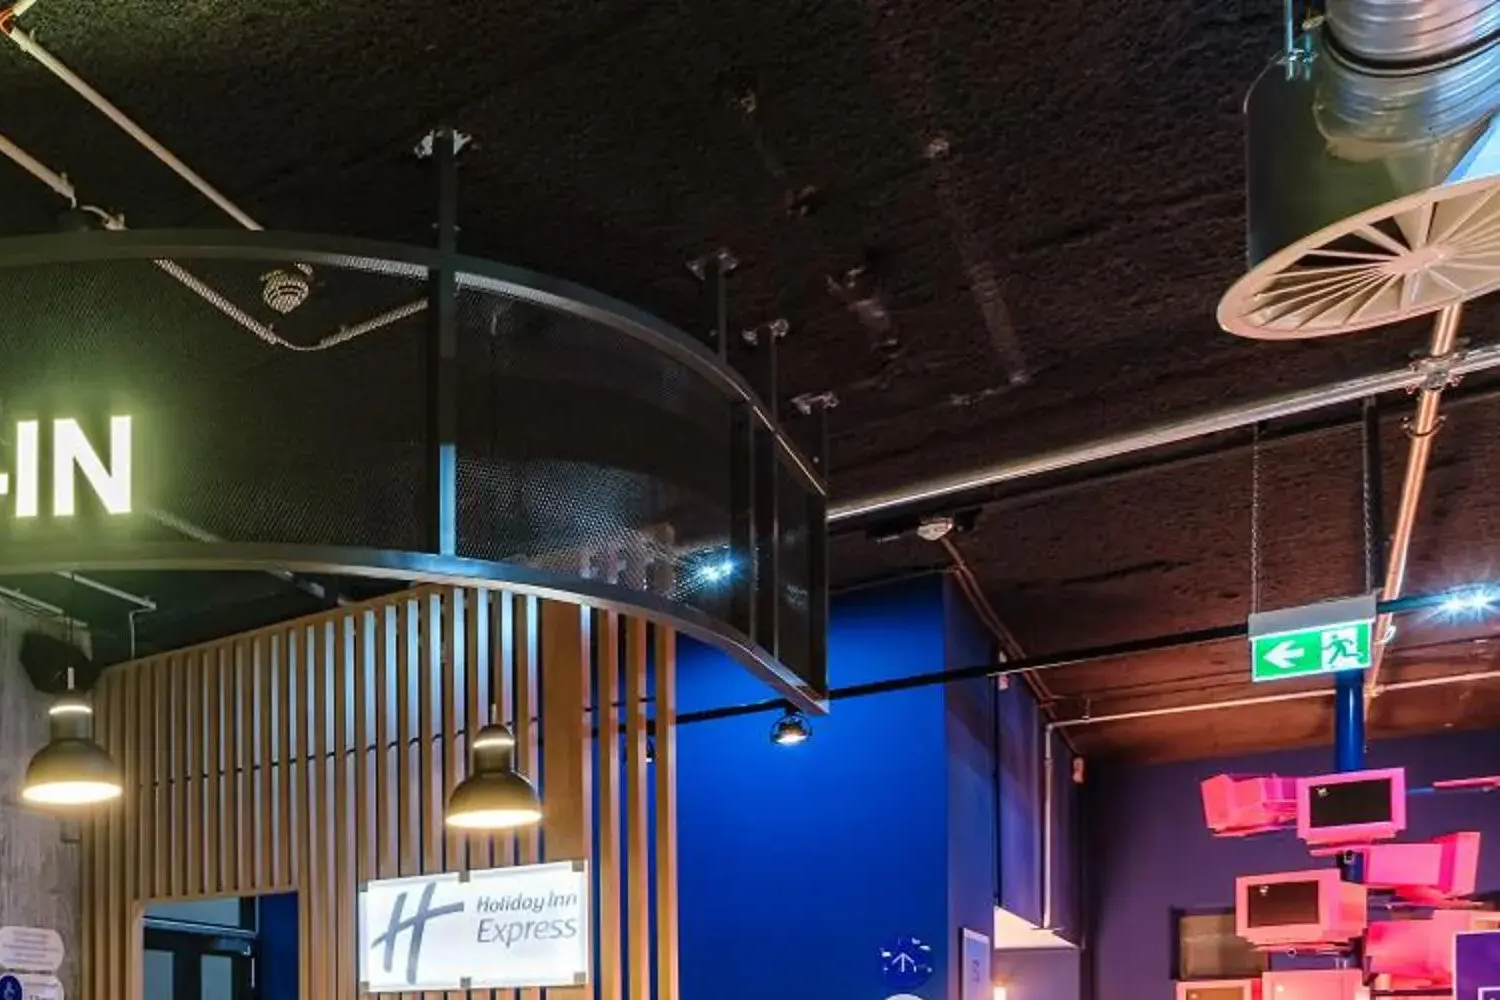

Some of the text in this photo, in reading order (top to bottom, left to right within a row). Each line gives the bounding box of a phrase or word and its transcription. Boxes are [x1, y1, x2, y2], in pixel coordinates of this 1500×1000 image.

[476, 890, 578, 914] Holiday Inn
[476, 917, 578, 948] Express
